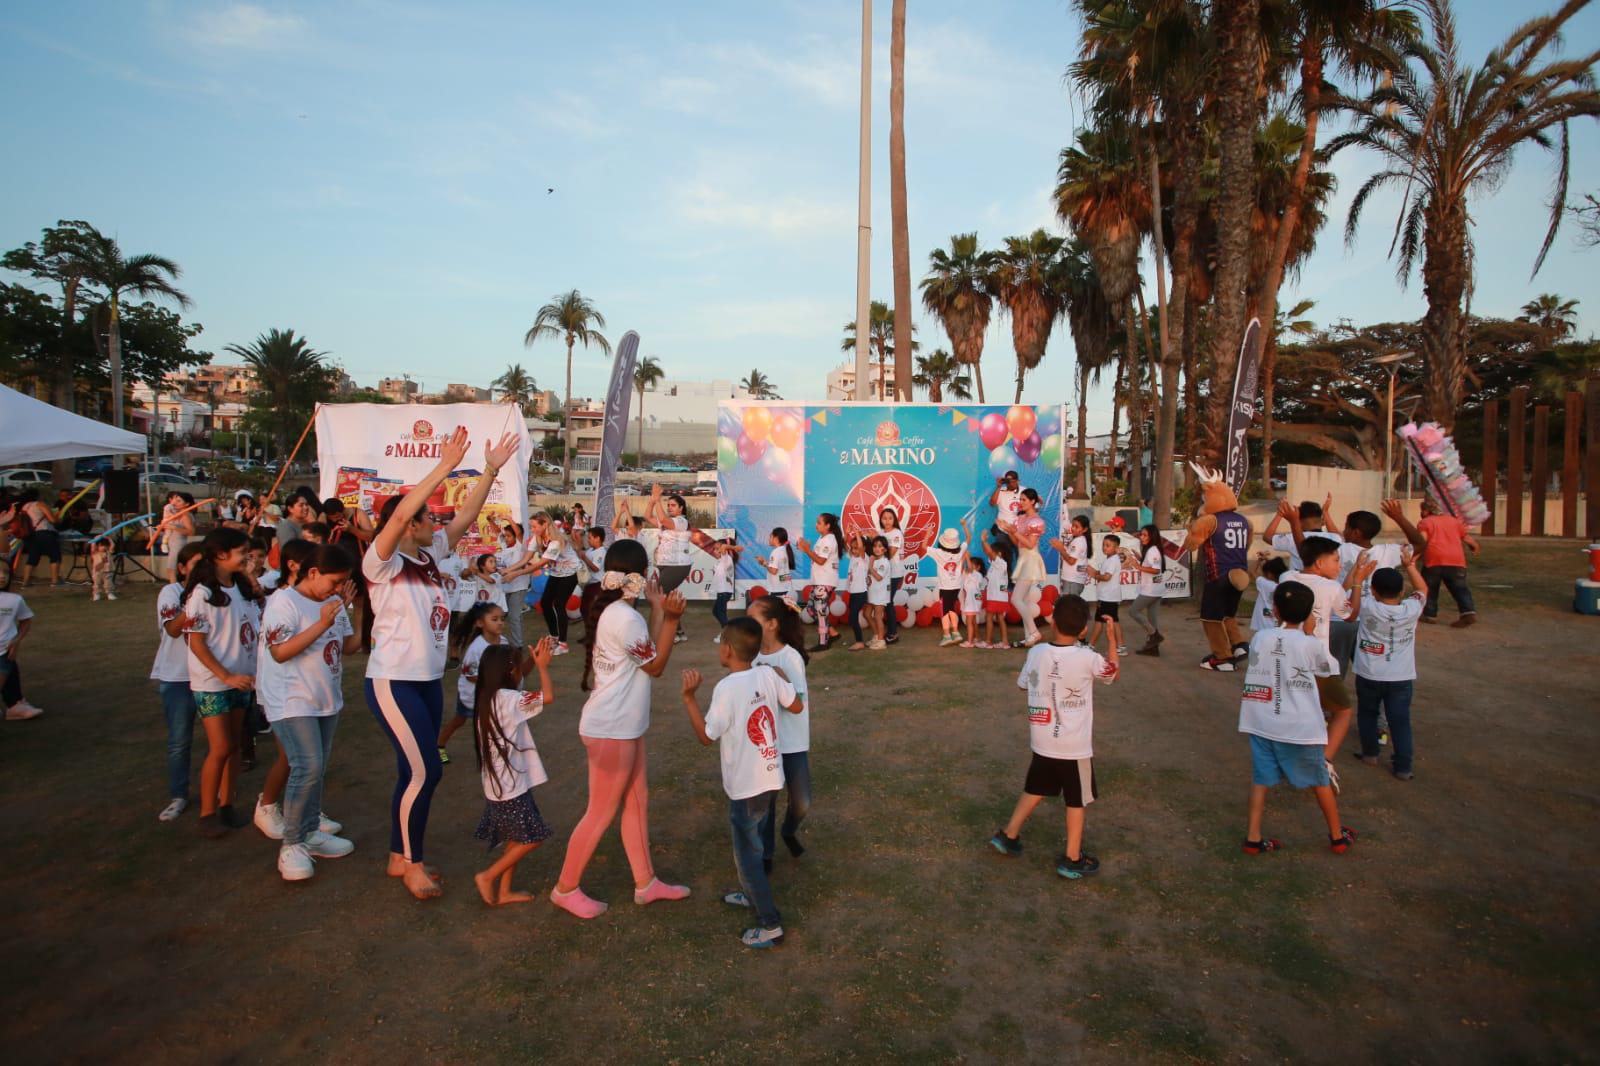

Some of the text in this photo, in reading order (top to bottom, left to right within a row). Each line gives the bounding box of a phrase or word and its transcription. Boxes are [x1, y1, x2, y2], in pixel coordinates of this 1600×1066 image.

[394, 442, 441, 458] MARI
[851, 447, 936, 465] MARINO
[1224, 528, 1248, 549] 911
